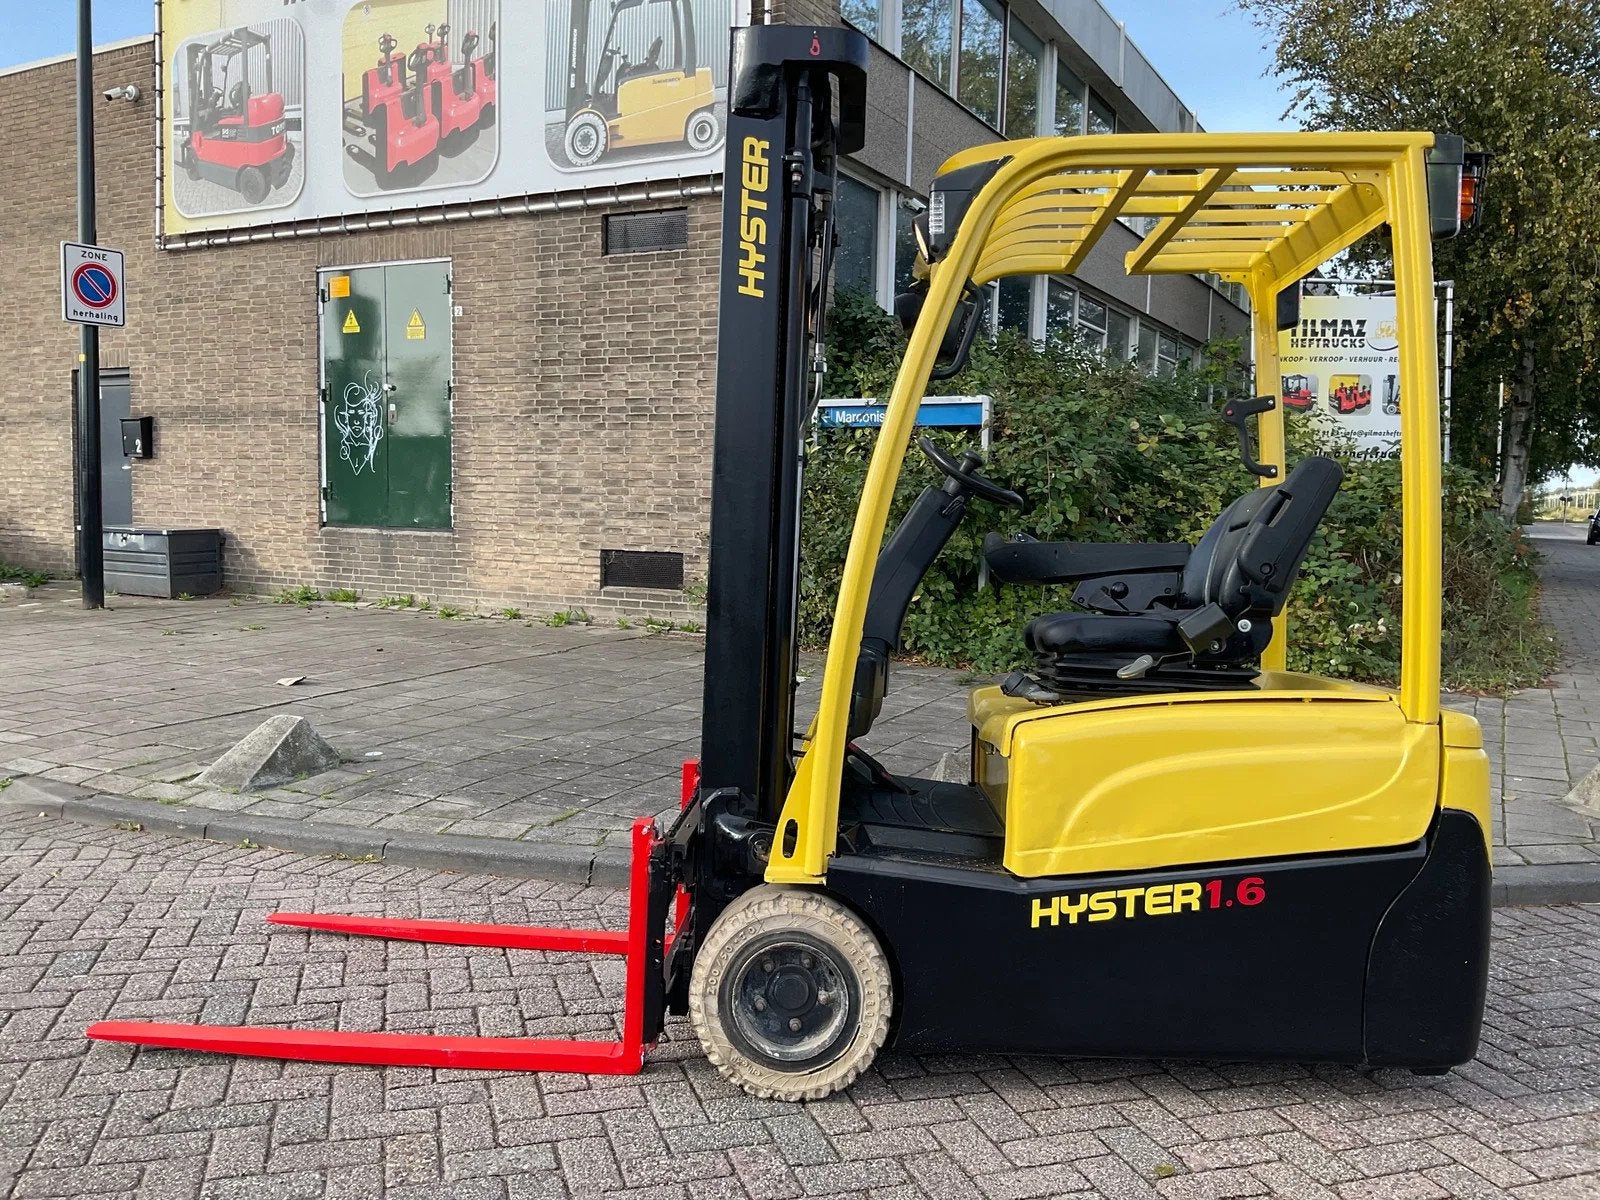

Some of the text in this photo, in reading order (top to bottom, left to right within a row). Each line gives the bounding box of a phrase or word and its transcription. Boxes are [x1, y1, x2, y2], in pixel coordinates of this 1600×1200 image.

[738, 136, 770, 299] HYSTER
[80, 250, 108, 262] ZONE
[73, 308, 119, 323] herhaling
[1290, 338, 1367, 349] HEFTRUCKS
[835, 410, 887, 424] Marconis
[135, 438, 142, 454] 2
[1031, 876, 1266, 929] HYSTER 1.6
